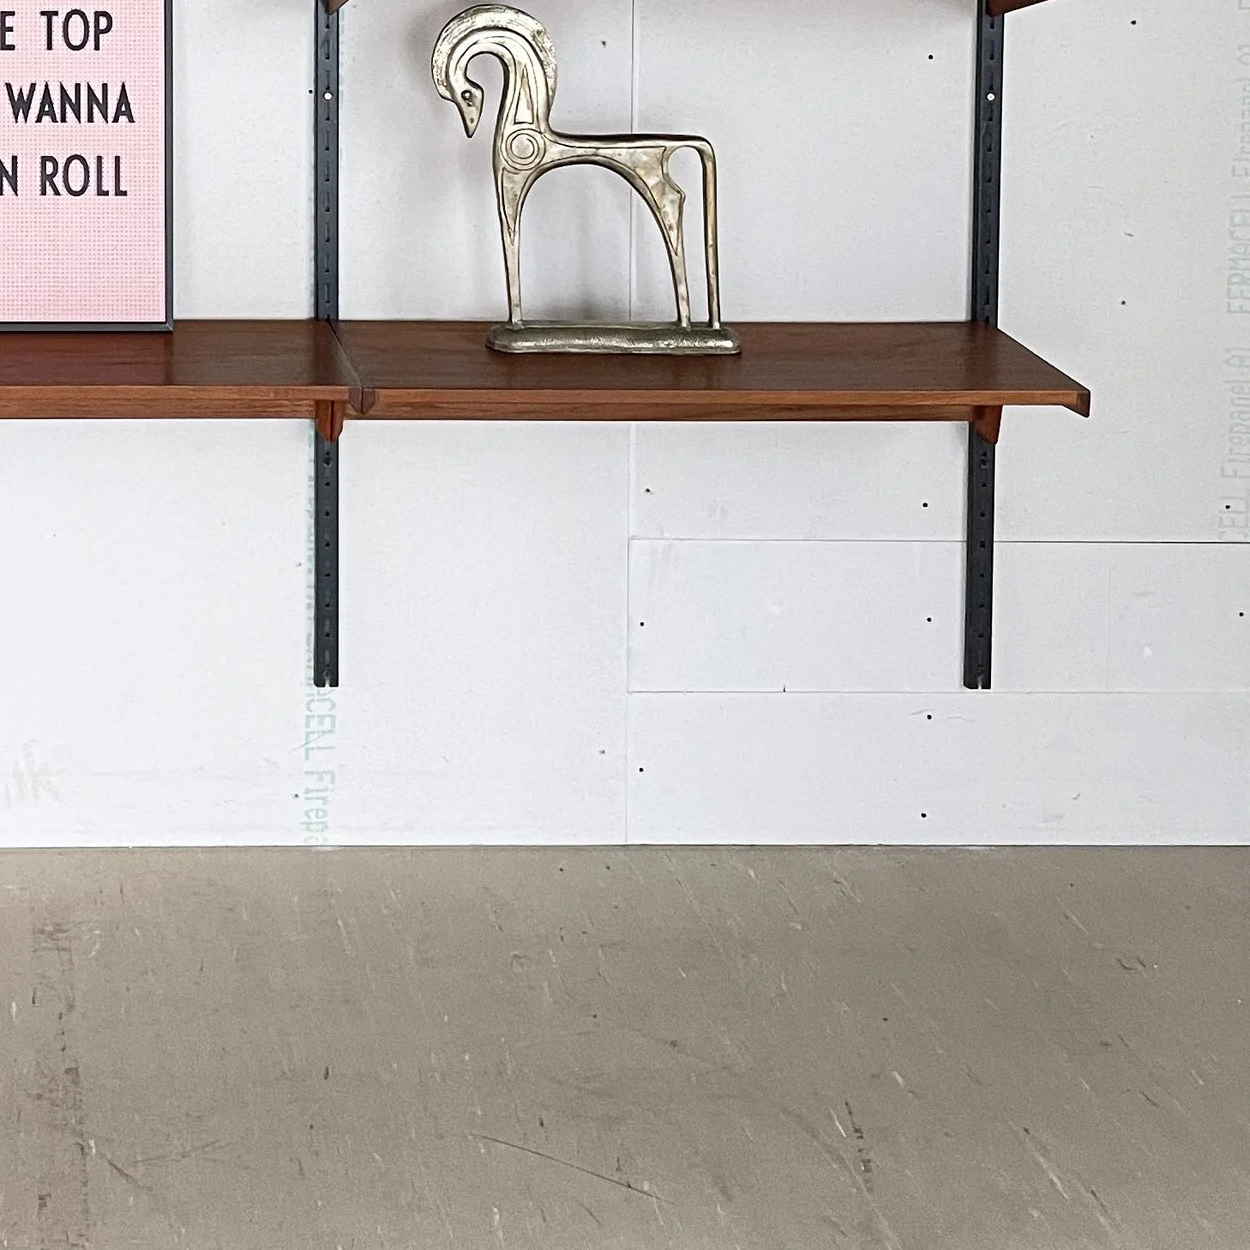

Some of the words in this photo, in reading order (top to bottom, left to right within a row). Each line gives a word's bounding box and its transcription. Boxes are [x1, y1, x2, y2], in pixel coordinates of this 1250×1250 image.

[40, 9, 113, 51] TOP
[5, 81, 136, 123] WANNA
[39, 154, 128, 196] ROLL
